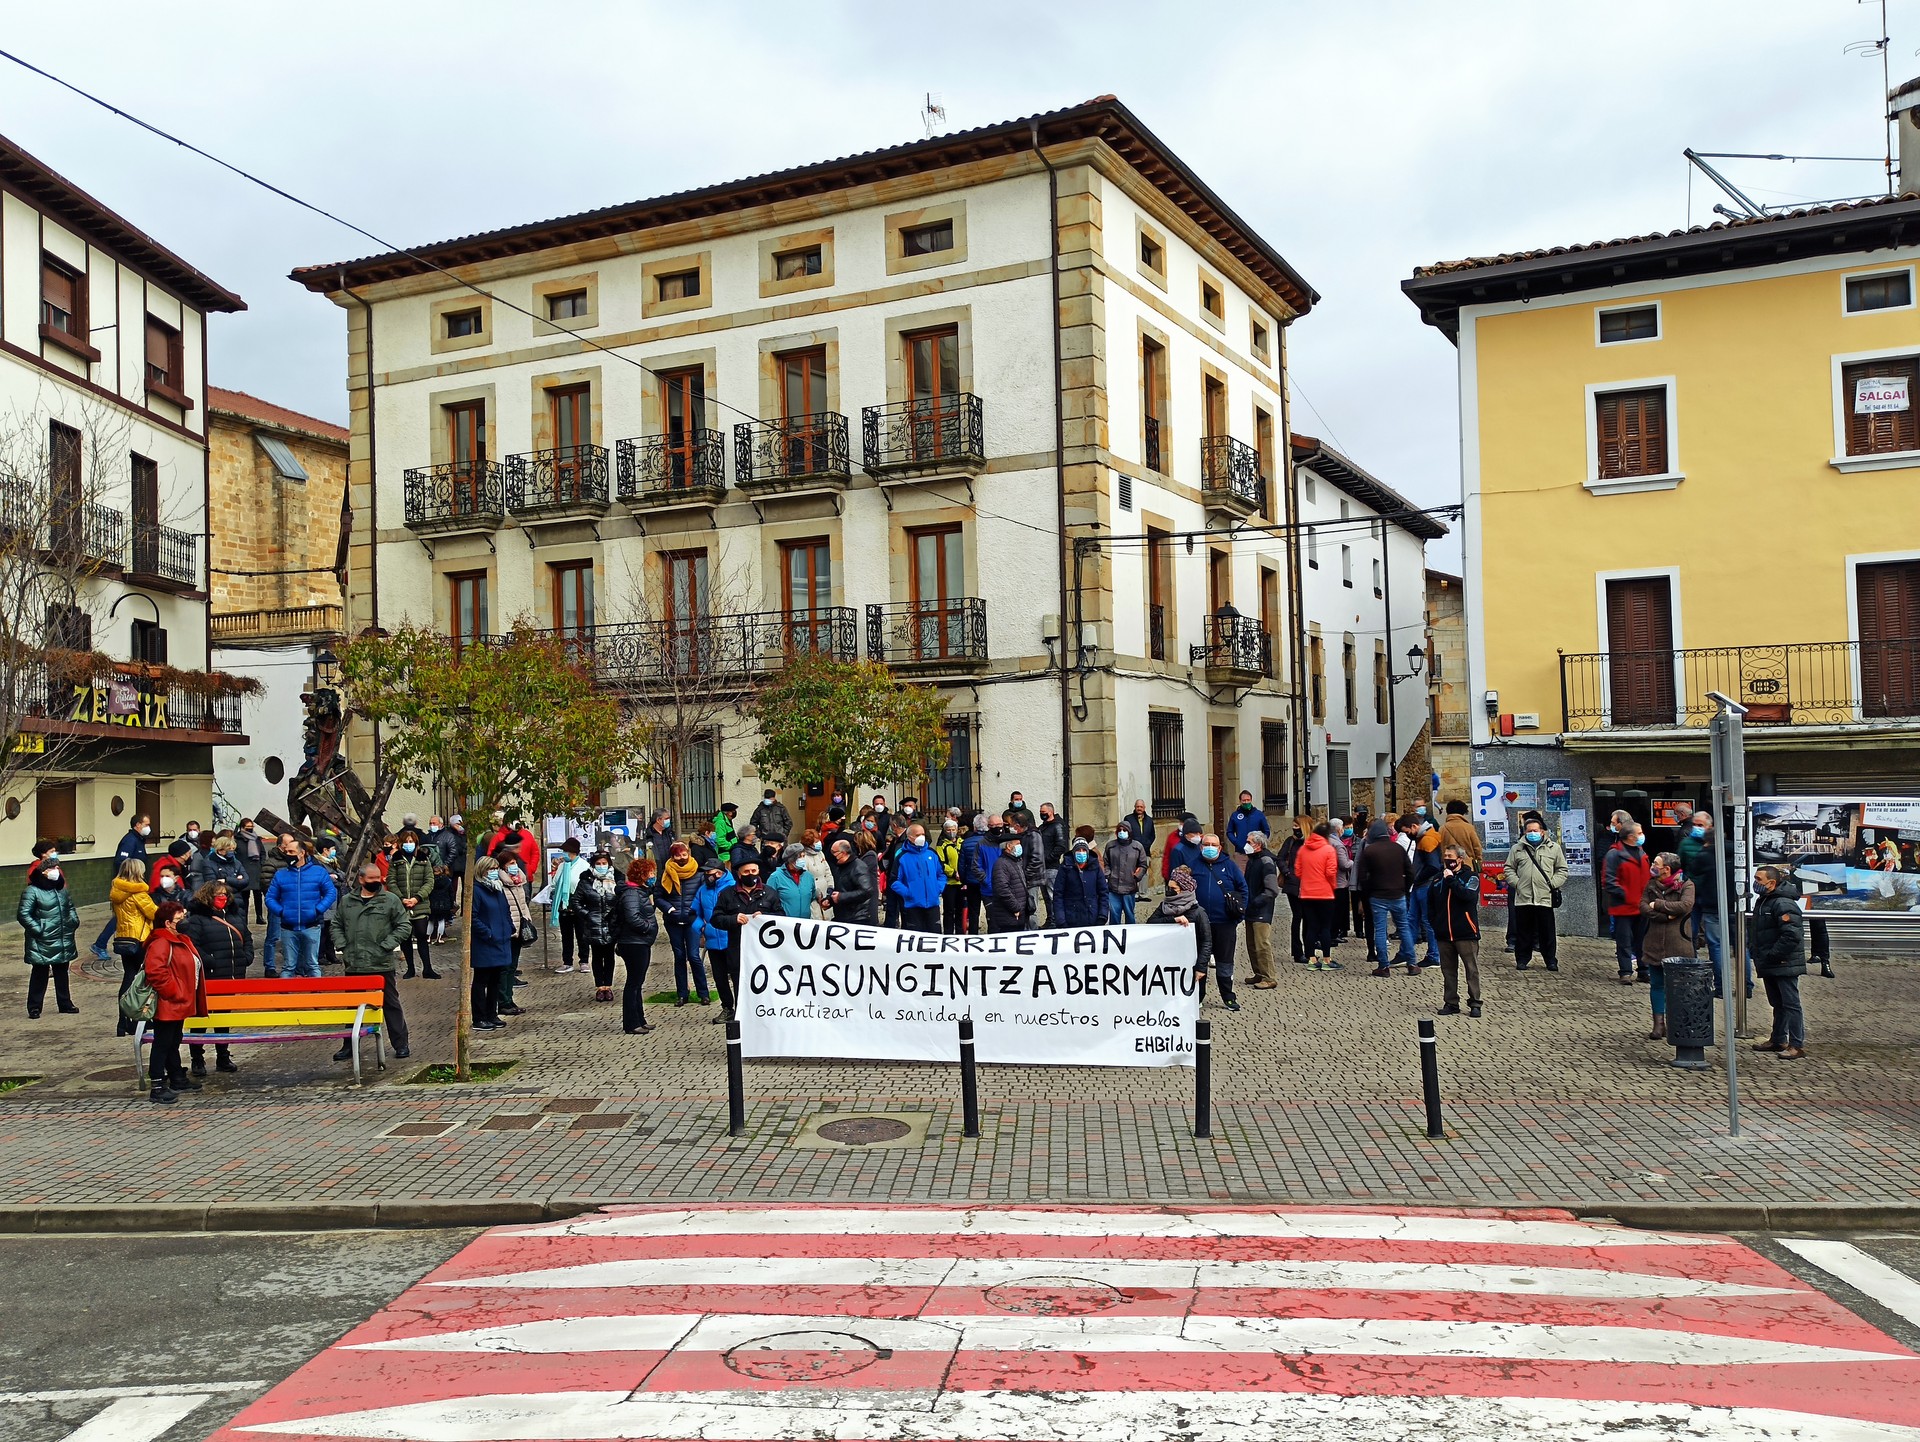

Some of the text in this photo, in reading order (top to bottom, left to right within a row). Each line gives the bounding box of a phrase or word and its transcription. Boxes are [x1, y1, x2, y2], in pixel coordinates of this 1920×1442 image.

[1859, 390, 1905, 401] SALGAI
[1753, 681, 1776, 692] 1883
[1653, 801, 1662, 809] SE
[758, 920, 1127, 955] GURE HERRIETAN
[750, 963, 1197, 999] OSASUNGINTZA BERMATU
[755, 1001, 1181, 1030] Garantizar la sanidad en nuestros pueblos
[1134, 1034, 1194, 1053] EHBildu
